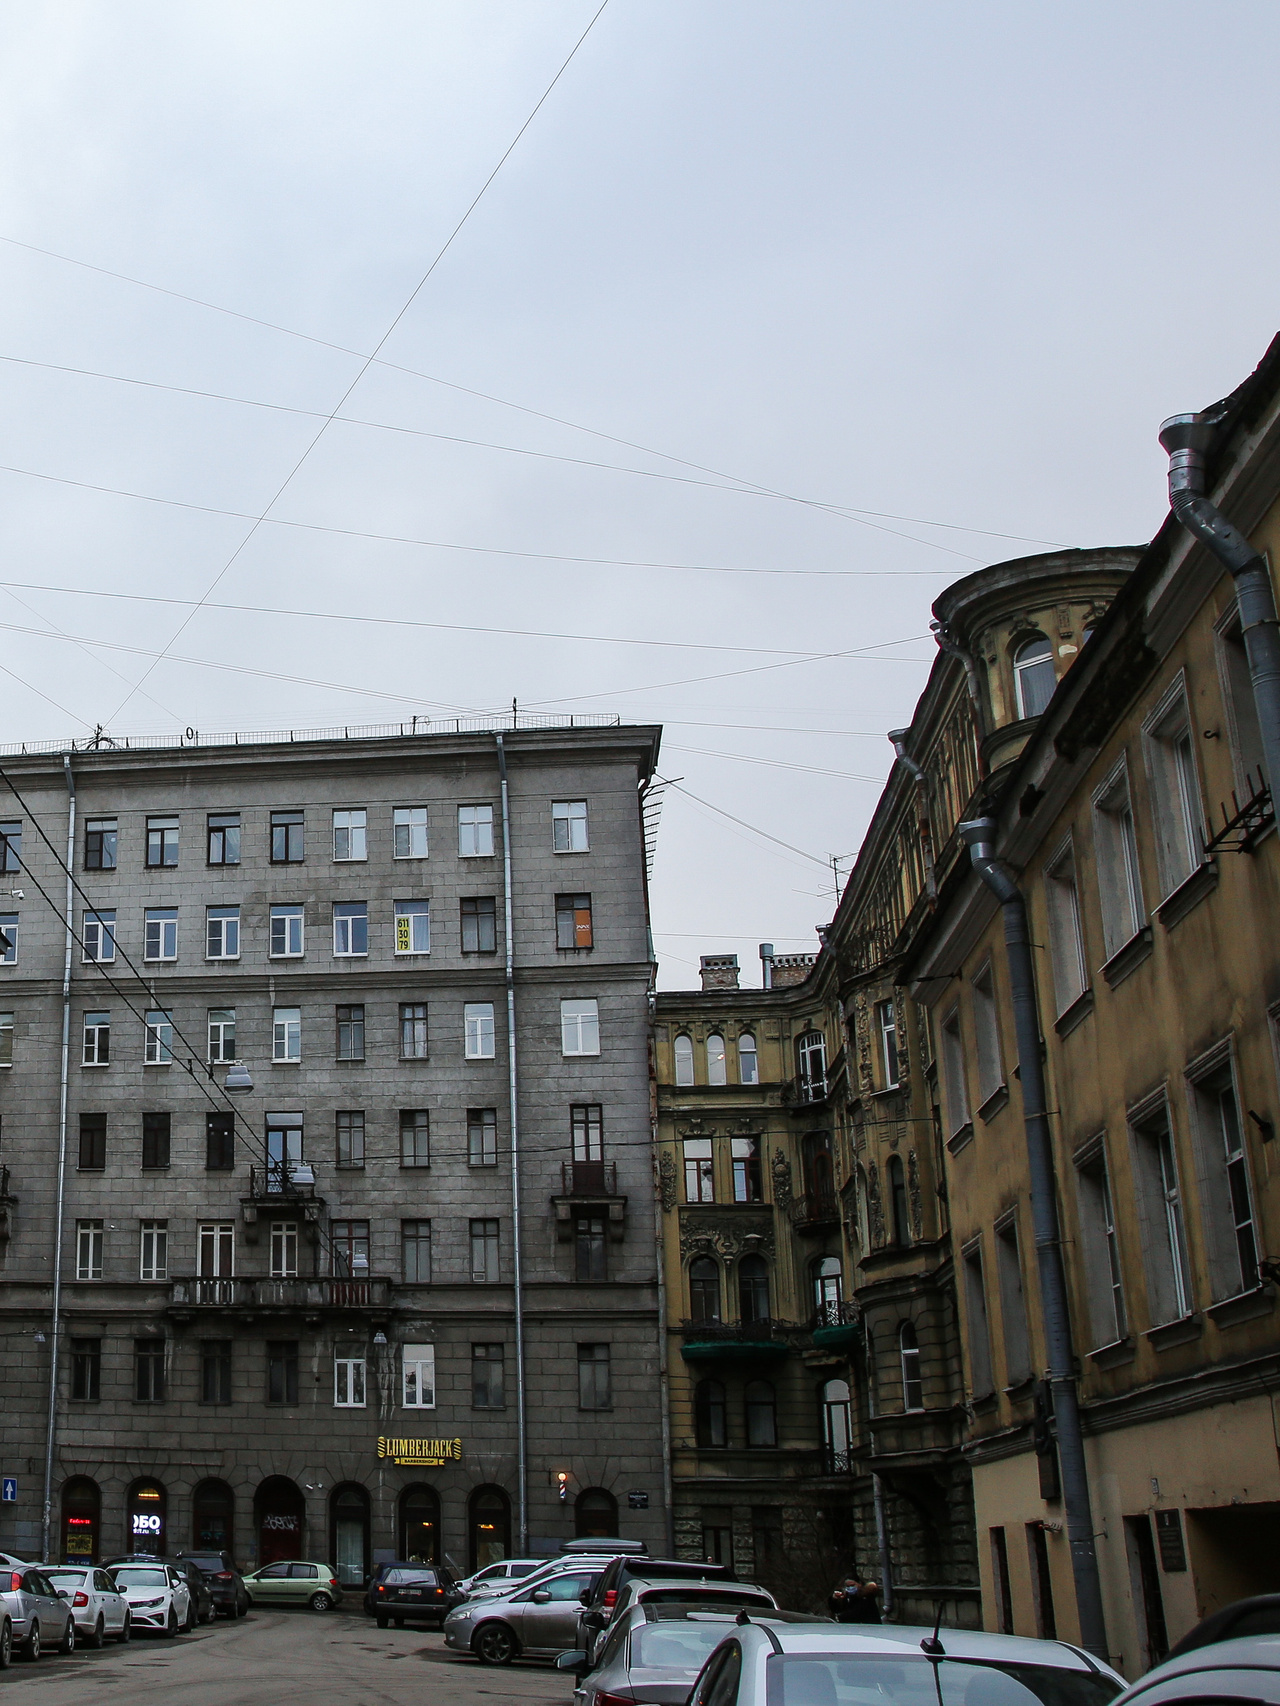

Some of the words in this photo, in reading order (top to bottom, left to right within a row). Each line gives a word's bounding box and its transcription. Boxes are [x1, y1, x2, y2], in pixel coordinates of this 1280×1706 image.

[397, 918, 409, 928] 611
[398, 929, 408, 938] 30
[399, 940, 408, 949] 79
[386, 1438, 453, 1457] LUMBERJACK
